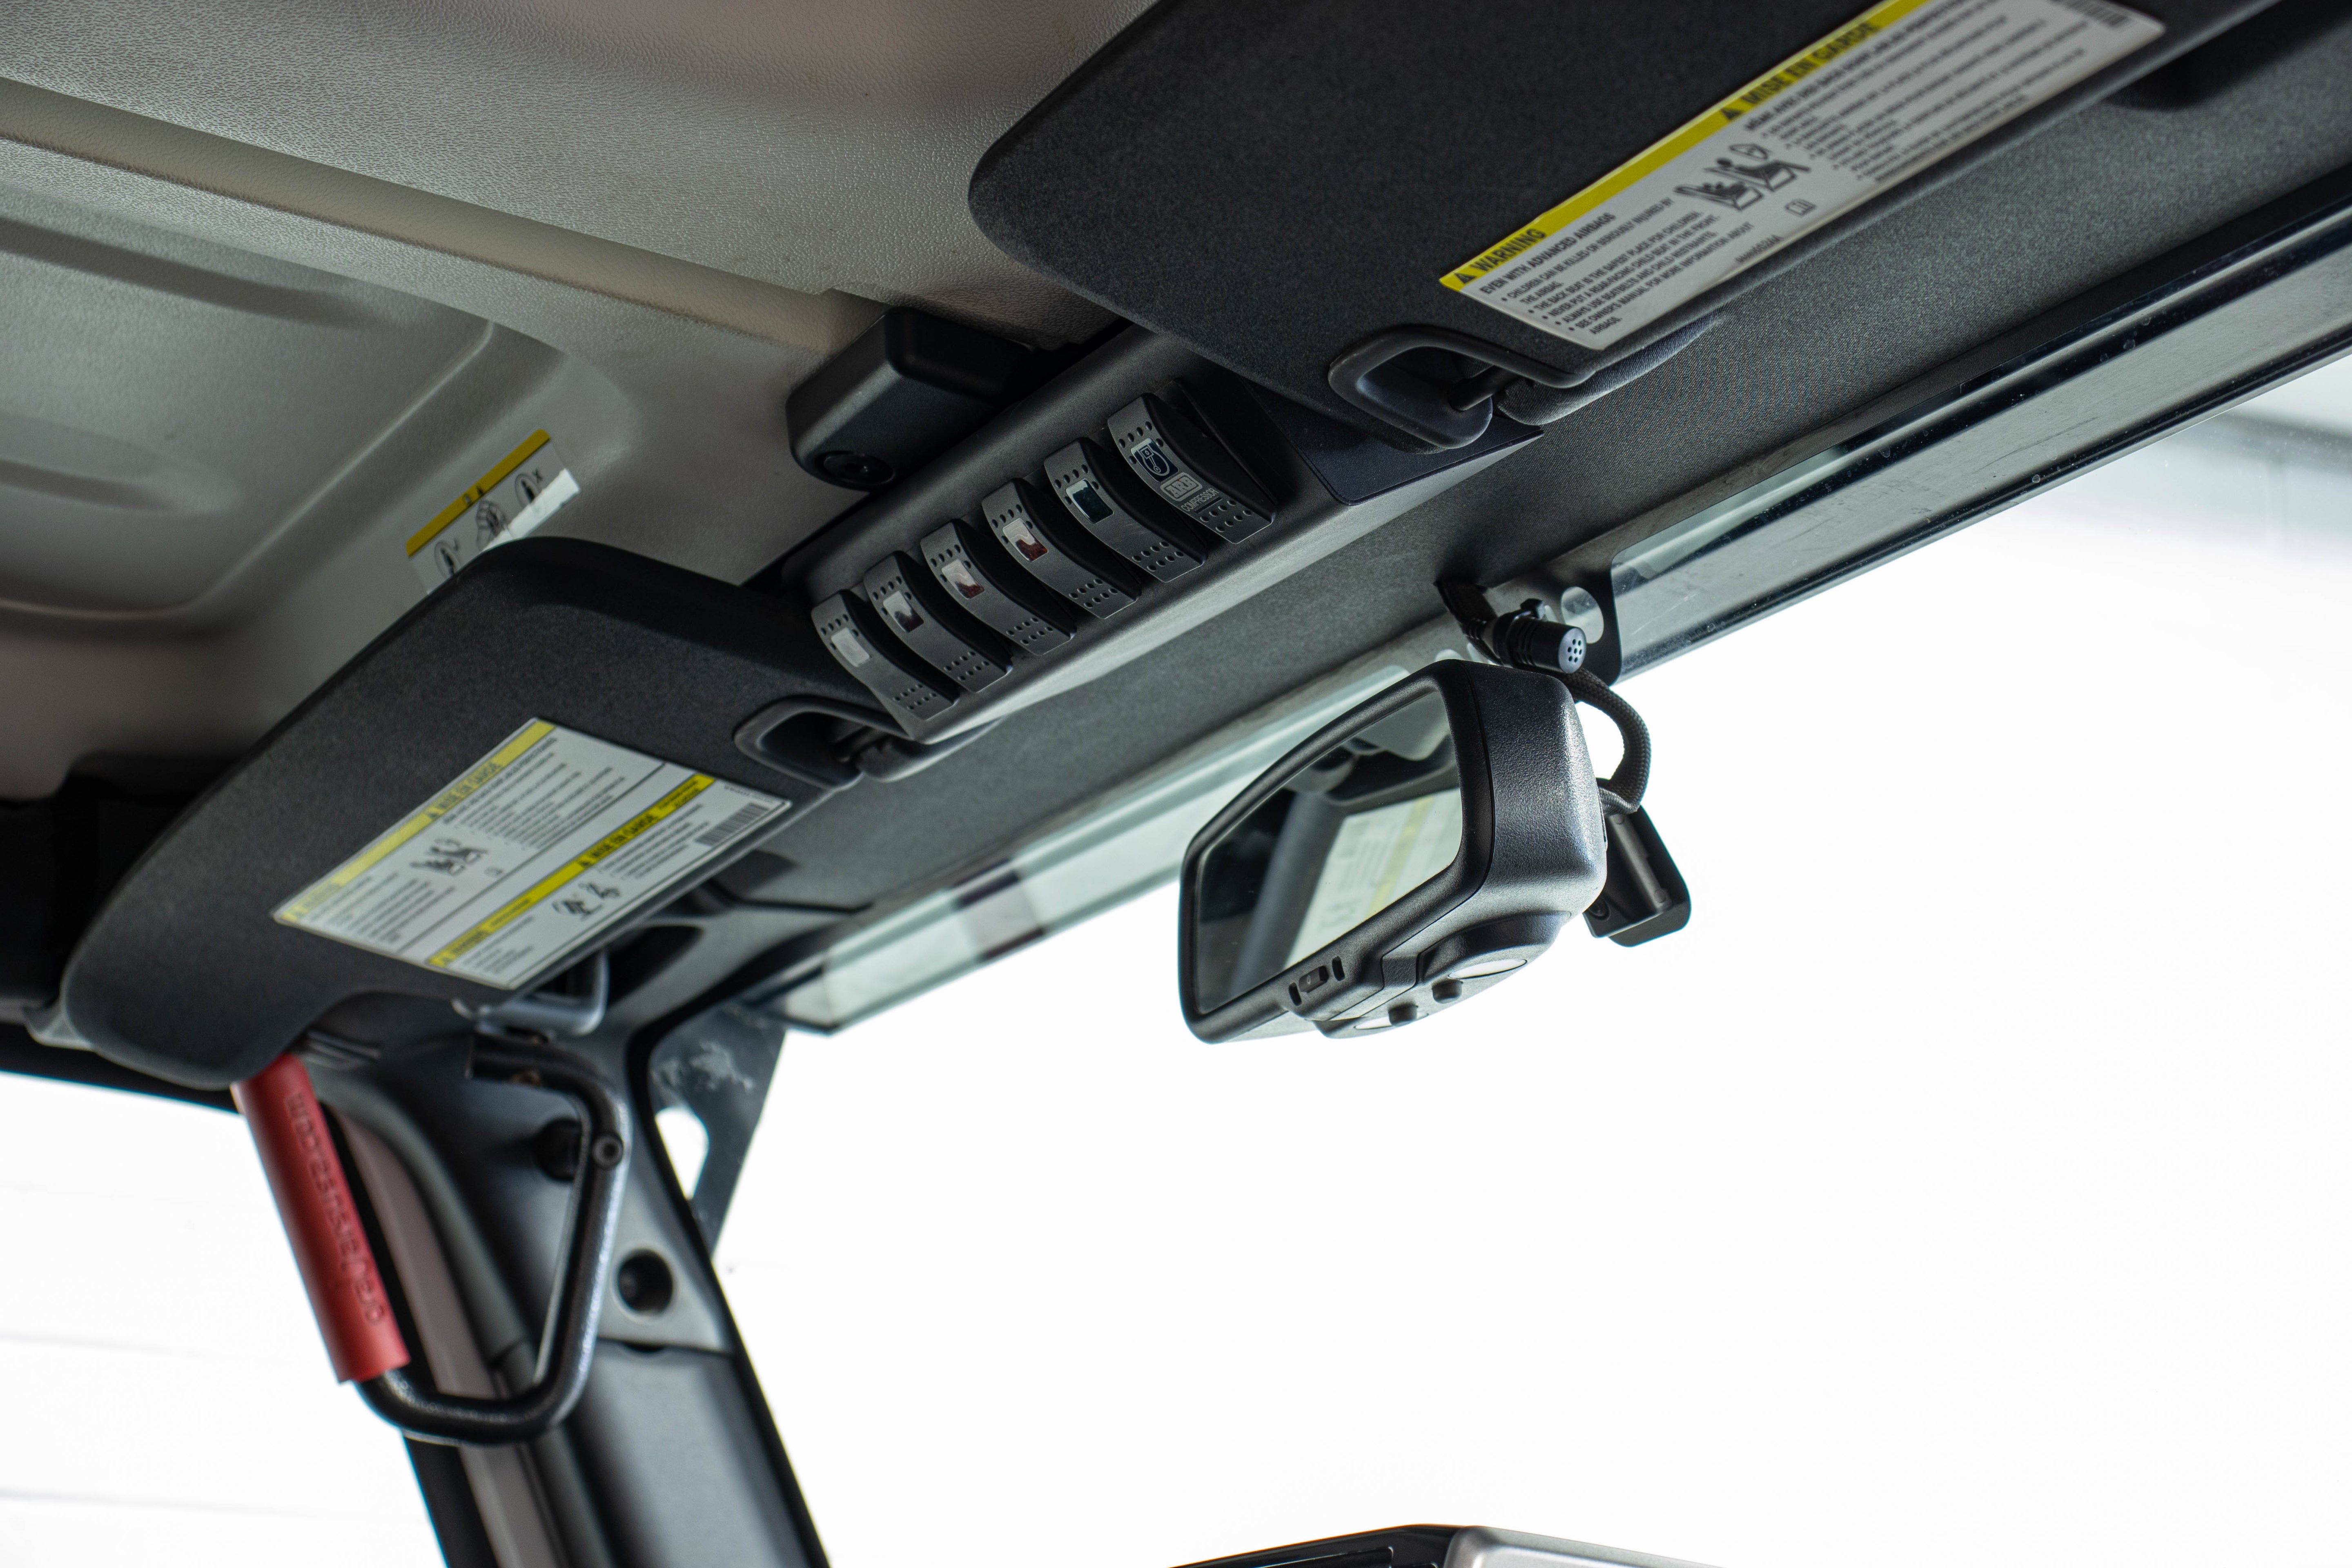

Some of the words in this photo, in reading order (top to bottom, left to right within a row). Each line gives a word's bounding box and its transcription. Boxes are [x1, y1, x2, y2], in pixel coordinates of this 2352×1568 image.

[1738, 74, 1795, 106] MISE
[1784, 58, 1821, 78] EN
[1810, 21, 1882, 62] GARDE
[1470, 227, 1547, 272] WARNING
[1479, 278, 1508, 294] EVEN
[1503, 265, 1530, 280] WITH
[1525, 236, 1578, 266] ADVANCED
[1570, 212, 1617, 238] AIRBAGS
[1507, 278, 1543, 298] CHILDREN
[1539, 270, 1557, 279] CAN
[1563, 250, 1591, 265] KILLED
[1595, 221, 1637, 245] SERIOUSLY
[1630, 203, 1666, 223] INJURED
[1534, 301, 1552, 310] THE
[1547, 291, 1569, 303] BACK
[1564, 281, 1586, 292] SEAT
[1589, 269, 1606, 278] THE
[1601, 254, 1631, 270] SAFEST
[1626, 241, 1652, 255] PLACE
[1647, 232, 1667, 243] FOR
[1548, 303, 1573, 316] NEVER
[1569, 295, 1586, 304] PUT
[1588, 266, 1635, 292] REAR-FACING
[1630, 254, 1655, 267] CHILD
[1650, 244, 1672, 255] SEAT
[1676, 230, 1694, 239] THE
[1575, 319, 1592, 328] SEE
[1588, 302, 1622, 321] OWNER'S
[1617, 286, 1650, 304] MANUAL
[1645, 277, 1664, 287] FOR
[1659, 266, 1684, 278] MORE
[1678, 237, 1731, 266] INFORMATION
[1724, 222, 1756, 238] ABOUT
[1520, 295, 1538, 304] THE
[1533, 280, 1564, 296] AIRBAG.
[1561, 306, 1591, 322] ALWAYS
[1587, 298, 1605, 307] USE
[1600, 278, 1640, 299] SEATBELTS
[1635, 268, 1655, 279] AND
[1650, 256, 1676, 270] CHILD
[1588, 315, 1623, 334] AIRBAGS.
[1166, 476, 1198, 499] ARB
[1181, 488, 1219, 512] COMPRESSOR
